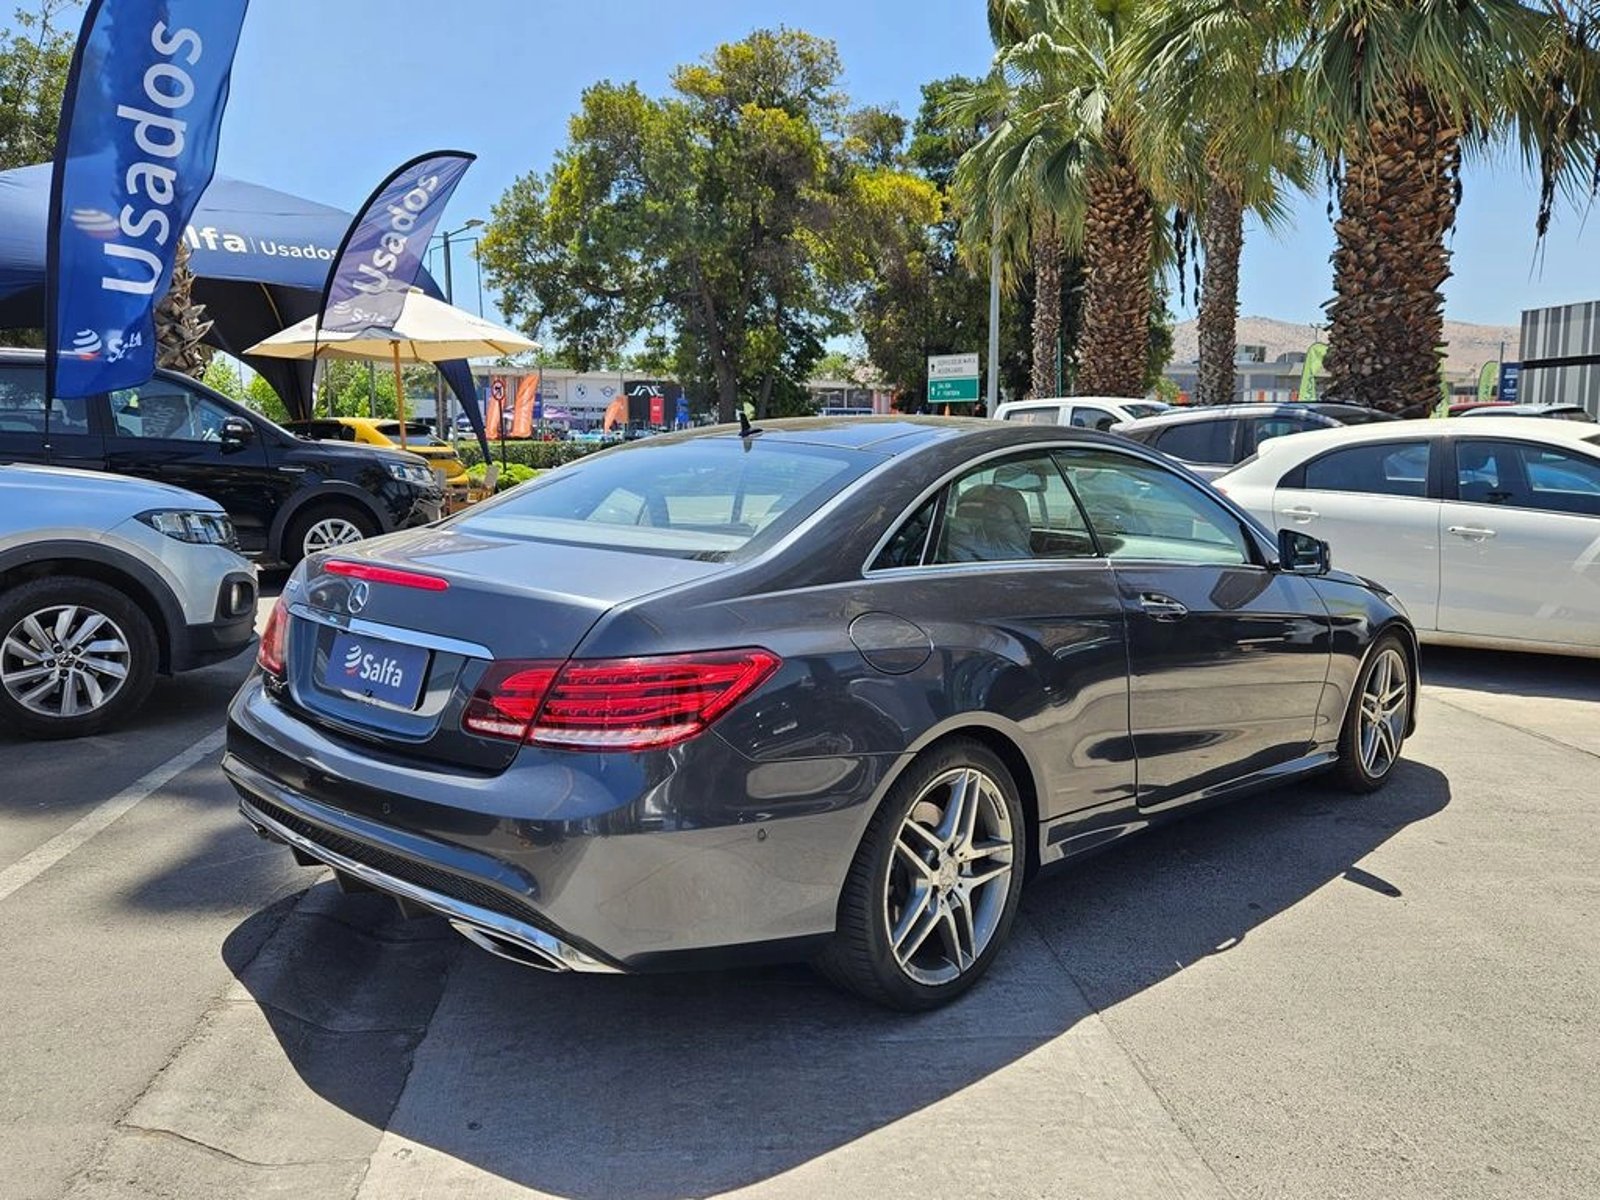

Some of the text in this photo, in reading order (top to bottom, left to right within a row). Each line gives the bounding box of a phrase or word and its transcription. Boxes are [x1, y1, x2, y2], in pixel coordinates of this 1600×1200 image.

[101, 20, 203, 295] Usados
[182, 225, 248, 253] lfa
[352, 175, 439, 294] Usados
[360, 654, 403, 688] Salfa
